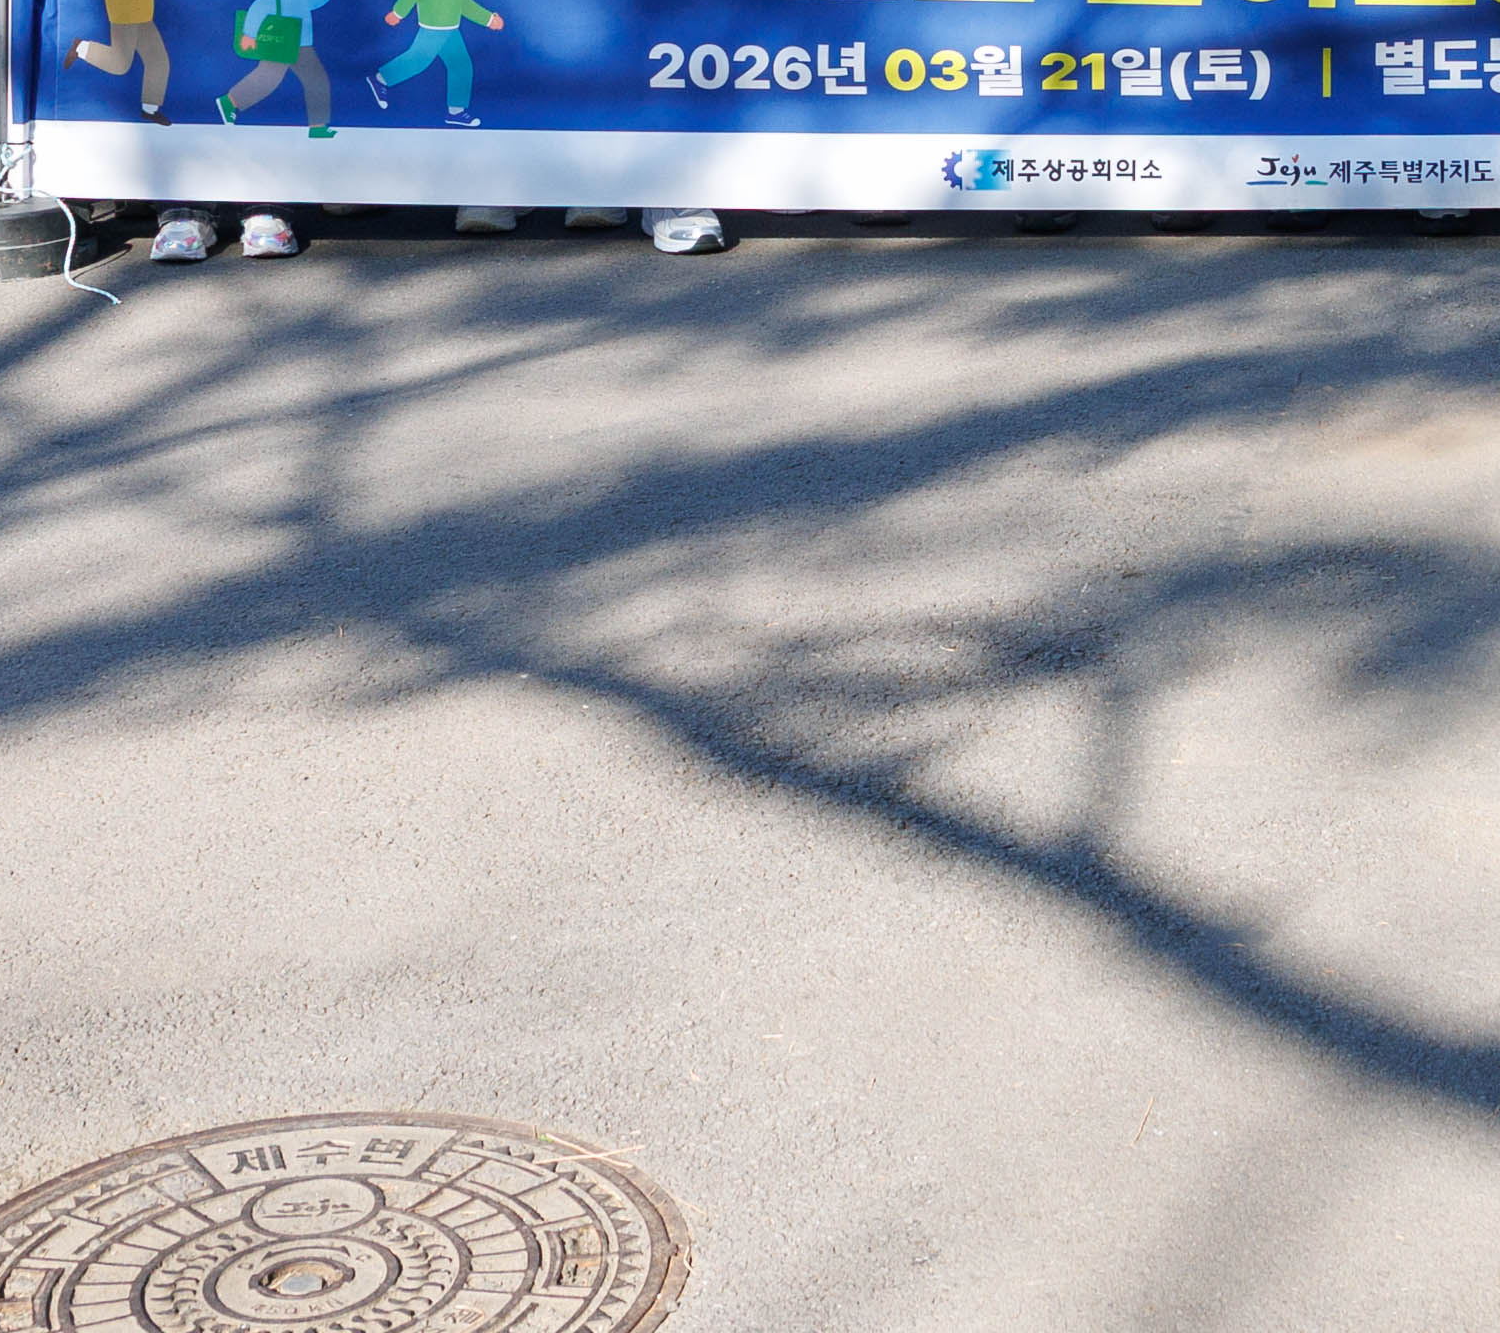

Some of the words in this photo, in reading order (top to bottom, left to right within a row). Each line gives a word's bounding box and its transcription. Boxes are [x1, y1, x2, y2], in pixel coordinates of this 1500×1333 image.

[648, 42, 868, 96] 2026년
[886, 44, 1024, 97] 03월
[1042, 45, 1272, 102] 21일(토)
[991, 158, 1163, 183] 제주상공회의소
[1256, 156, 1318, 186] Jeju
[1329, 158, 1495, 185] 제주특별자치도
[227, 1137, 421, 1174] 제수변
